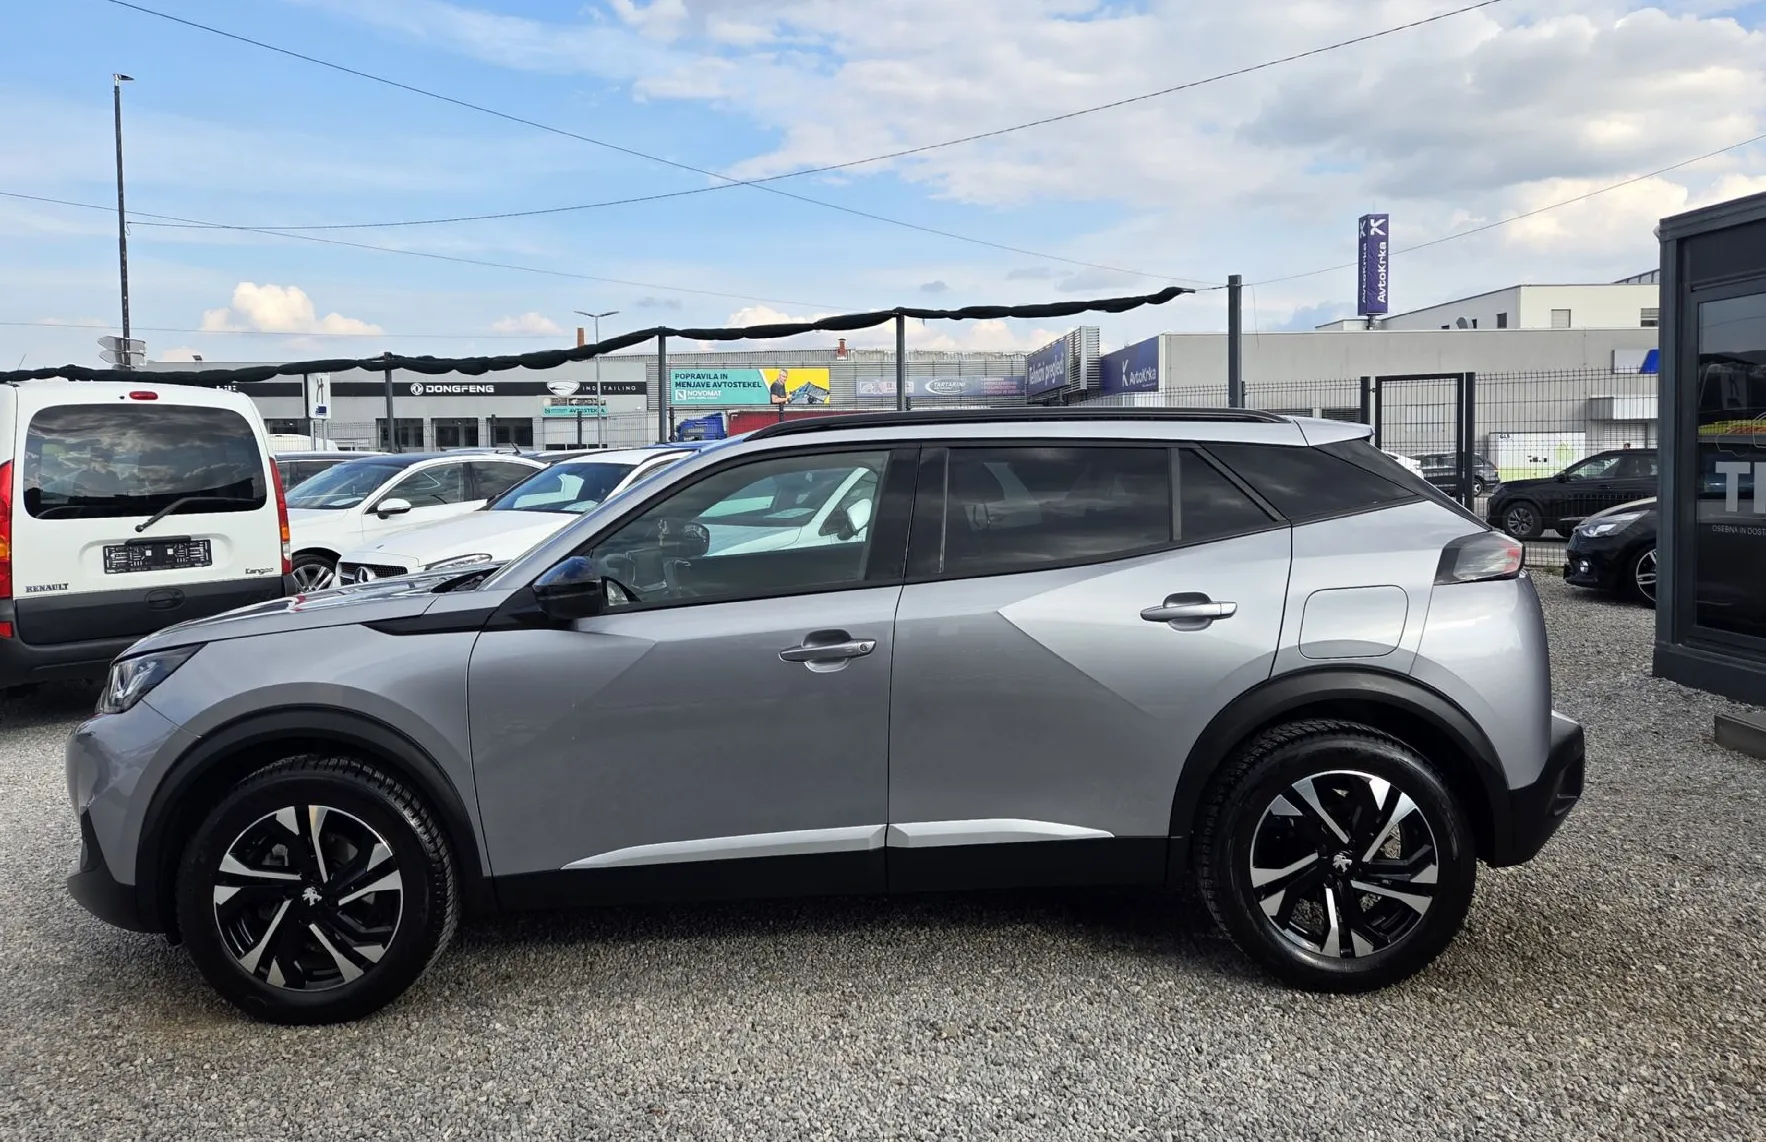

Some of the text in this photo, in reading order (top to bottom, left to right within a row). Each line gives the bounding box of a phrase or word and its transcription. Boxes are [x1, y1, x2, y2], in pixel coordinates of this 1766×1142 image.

[1377, 241, 1387, 303] AvtoKrka
[1130, 366, 1157, 386] AvtoKrka
[425, 385, 495, 393] DONGFENG
[1712, 525, 1738, 533] OSEBNA
[1747, 527, 1766, 536] DOST
[245, 567, 274, 575] Kangoo
[25, 583, 69, 593] RENAULT
